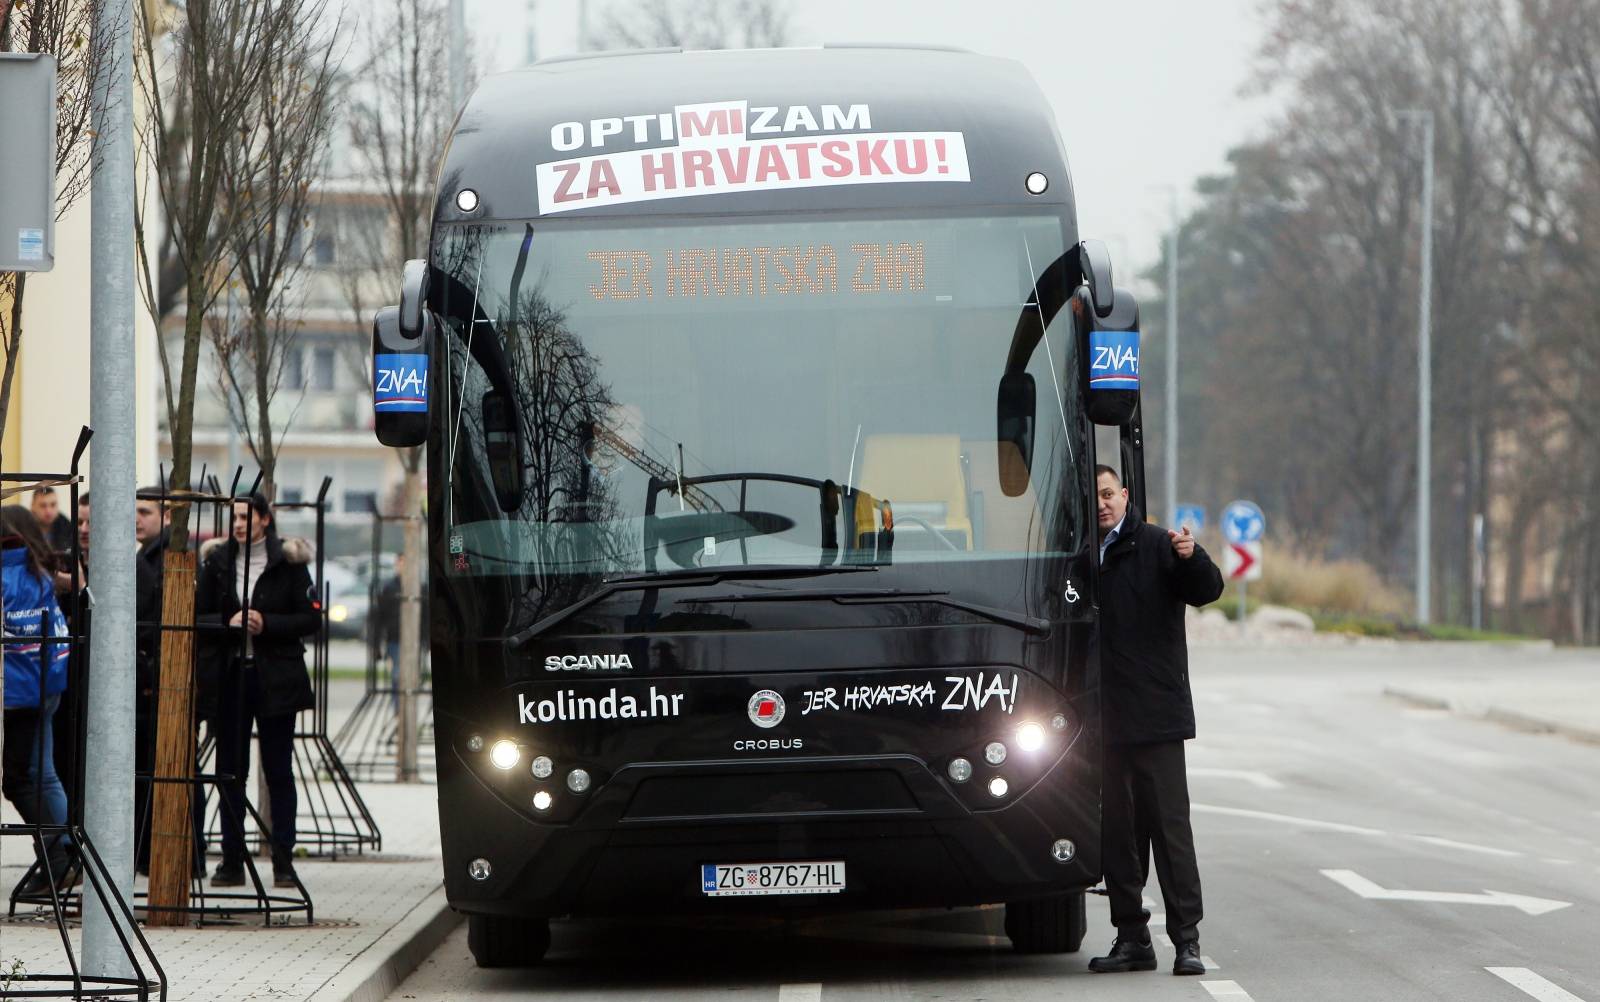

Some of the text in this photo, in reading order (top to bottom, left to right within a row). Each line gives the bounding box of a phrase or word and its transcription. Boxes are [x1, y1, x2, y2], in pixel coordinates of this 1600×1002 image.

[550, 103, 872, 152] OPTIMIZAM
[552, 138, 950, 204] ZA HRVATSKU!
[585, 241, 926, 300] JER HRVATSKA ZNA!
[1092, 344, 1140, 375] ZNA!
[376, 367, 428, 397] ZNA!
[544, 653, 634, 672] SCANIA
[517, 686, 684, 724] kolinda.hr
[801, 671, 1019, 716] JER HRVATSKA ZNA!
[733, 738, 803, 751] CROBUS
[718, 866, 745, 889] ZG
